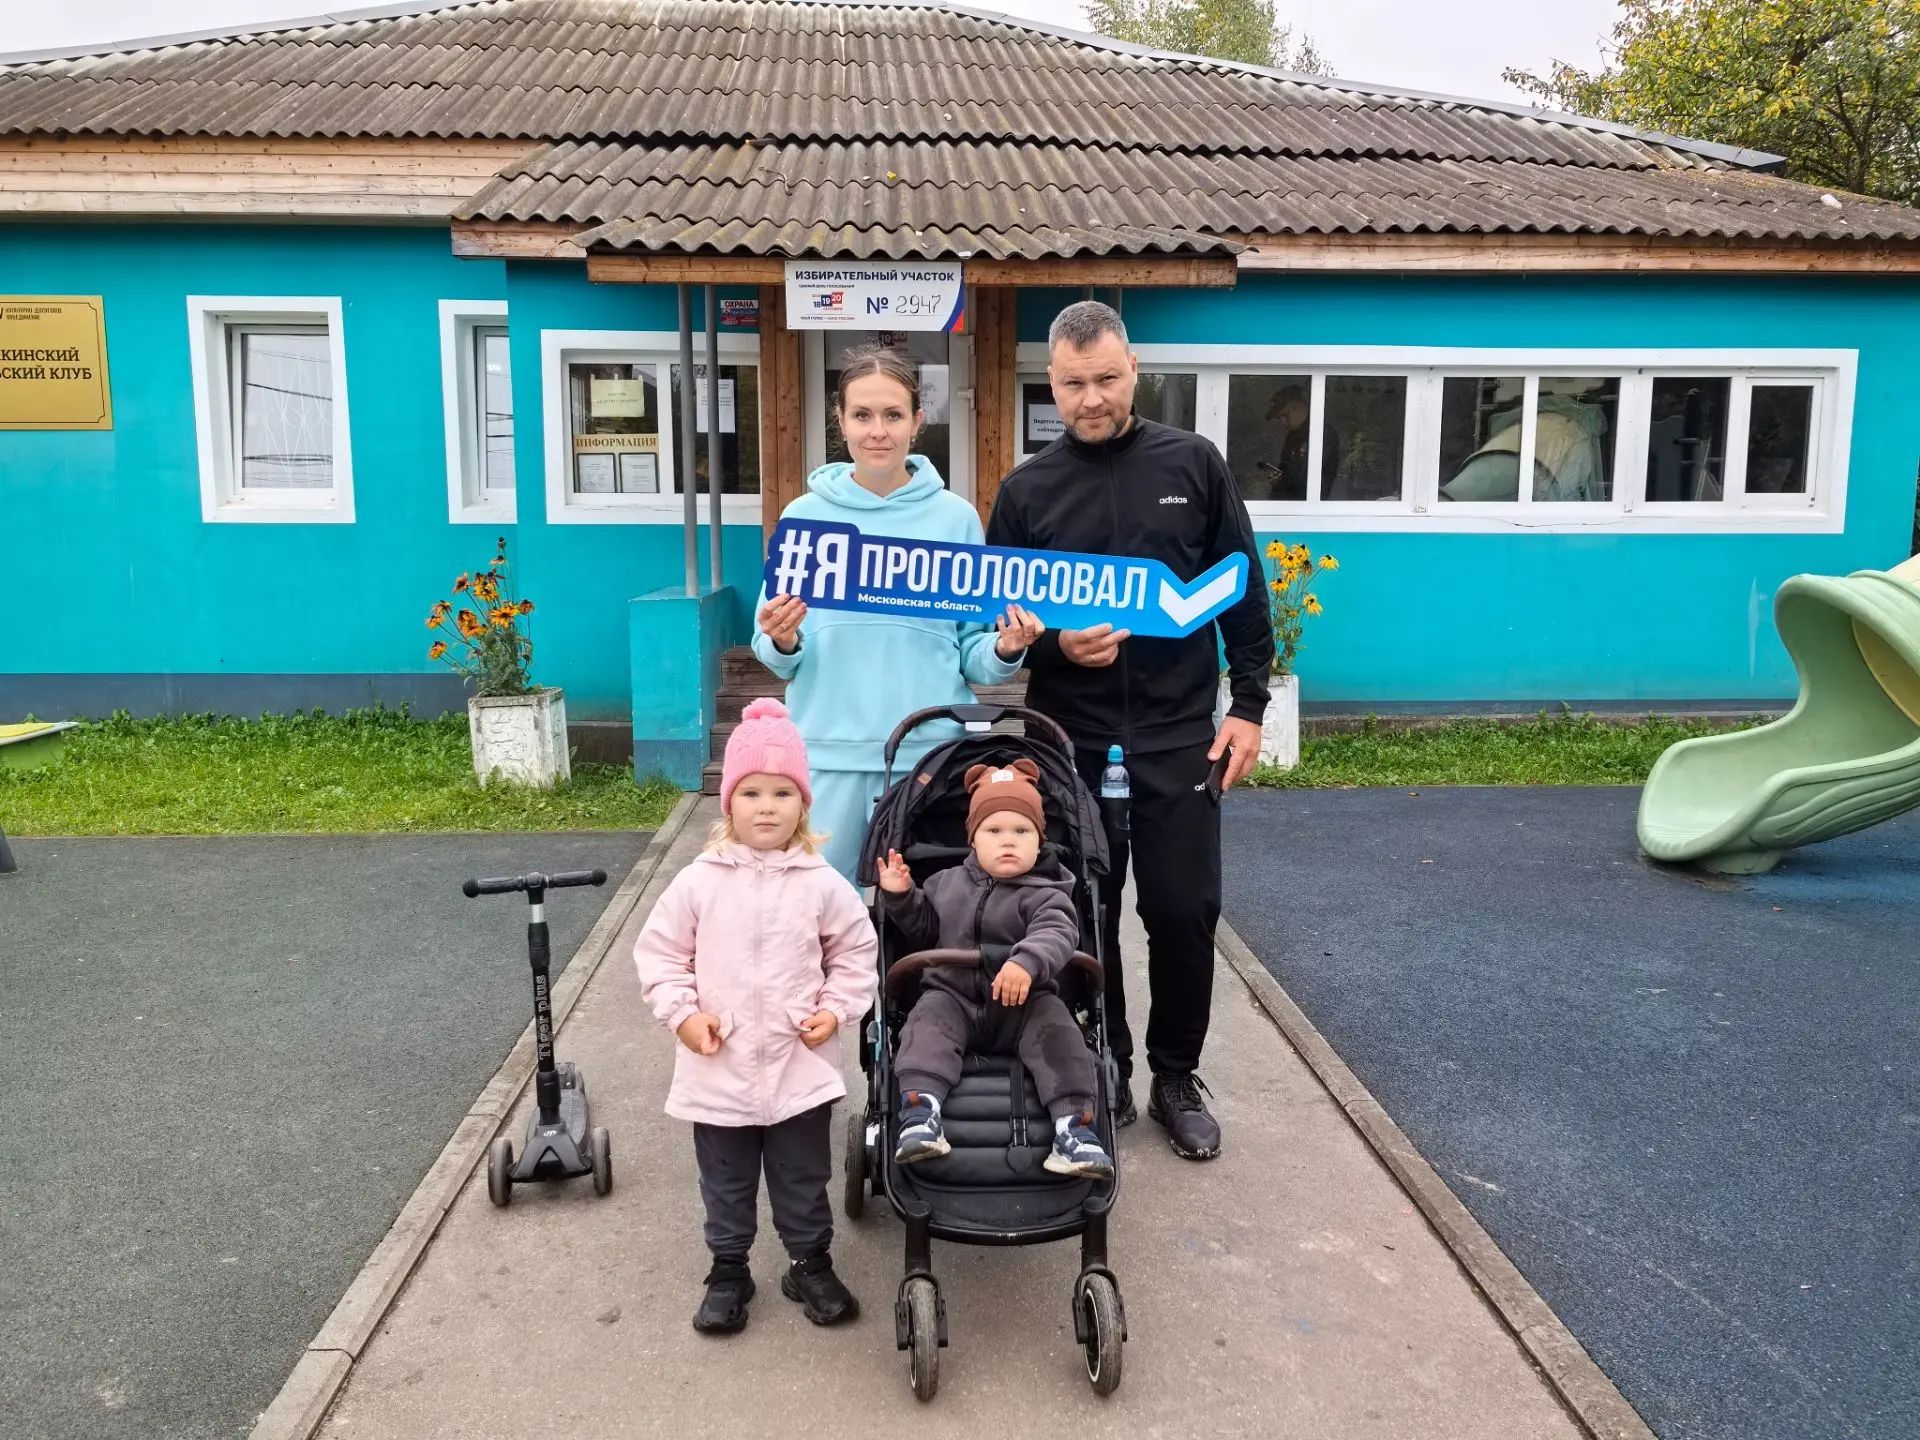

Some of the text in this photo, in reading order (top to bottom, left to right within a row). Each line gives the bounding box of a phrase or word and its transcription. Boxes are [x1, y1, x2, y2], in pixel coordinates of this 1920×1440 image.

[795, 270, 954, 281] ИЗБИРАТЕЛЬНЫЙ УЧАСТОК
[822, 297, 831, 305] 19
[832, 294, 841, 302] 20
[866, 294, 942, 314] № 2947
[0, 347, 80, 361] КИНСКИЙ
[50, 368, 92, 379] КЛУБ
[576, 438, 656, 448] ИНФОРМАЦИЯ
[1159, 496, 1187, 504] adidas
[774, 529, 1147, 610] #Я ПРОГОЛОСОВАЛ
[858, 593, 982, 613] Московская область
[1194, 782, 1205, 791] ad
[536, 975, 552, 1060] Tiger plus
